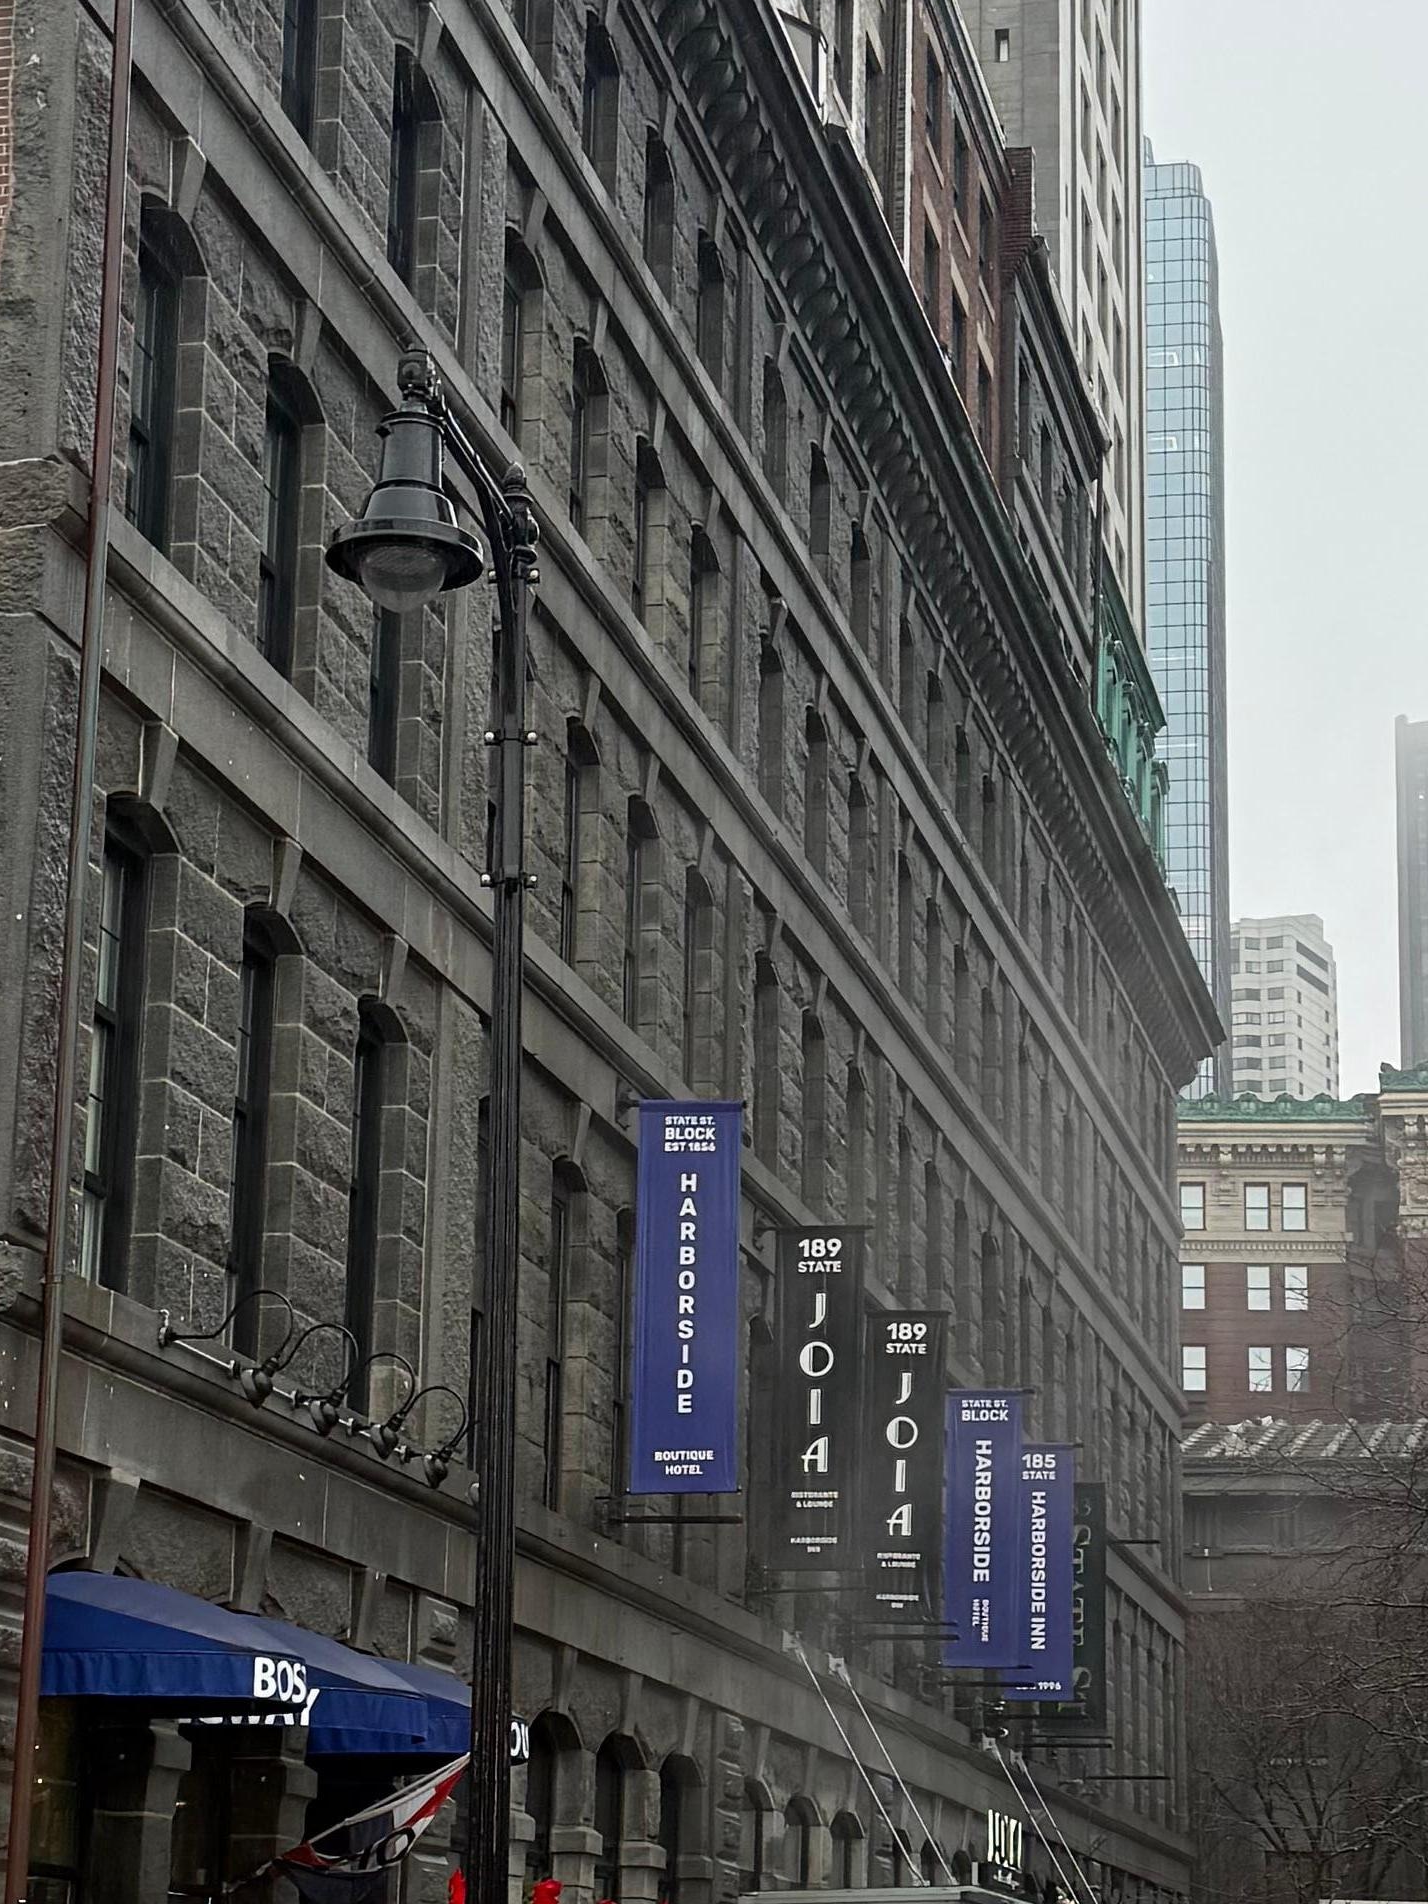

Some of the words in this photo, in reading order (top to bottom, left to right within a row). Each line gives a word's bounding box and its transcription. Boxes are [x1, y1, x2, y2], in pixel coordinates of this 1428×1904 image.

[664, 1116, 697, 1125] STATE
[664, 1127, 716, 1140] BLOCK
[664, 1143, 685, 1152] EST
[798, 1238, 842, 1258] 189
[798, 1261, 841, 1273] STATE
[677, 1173, 698, 1413] HARBORSIDE
[886, 1322, 927, 1340] 189
[886, 1343, 927, 1354] STATE
[799, 1293, 834, 1473] JOIA
[961, 1399, 992, 1408] STATE
[961, 1409, 1008, 1422] BLOCK
[654, 1450, 714, 1461] BOUTIQUE
[886, 1372, 918, 1536] JOIA
[1022, 1453, 1056, 1469] 185
[665, 1465, 703, 1475] HOTEL
[1022, 1471, 1056, 1480] STATE
[973, 1440, 993, 1582] HARBORSIDE
[1030, 1491, 1047, 1613] HARBORSIDE
[1030, 1618, 1046, 1649] INN
